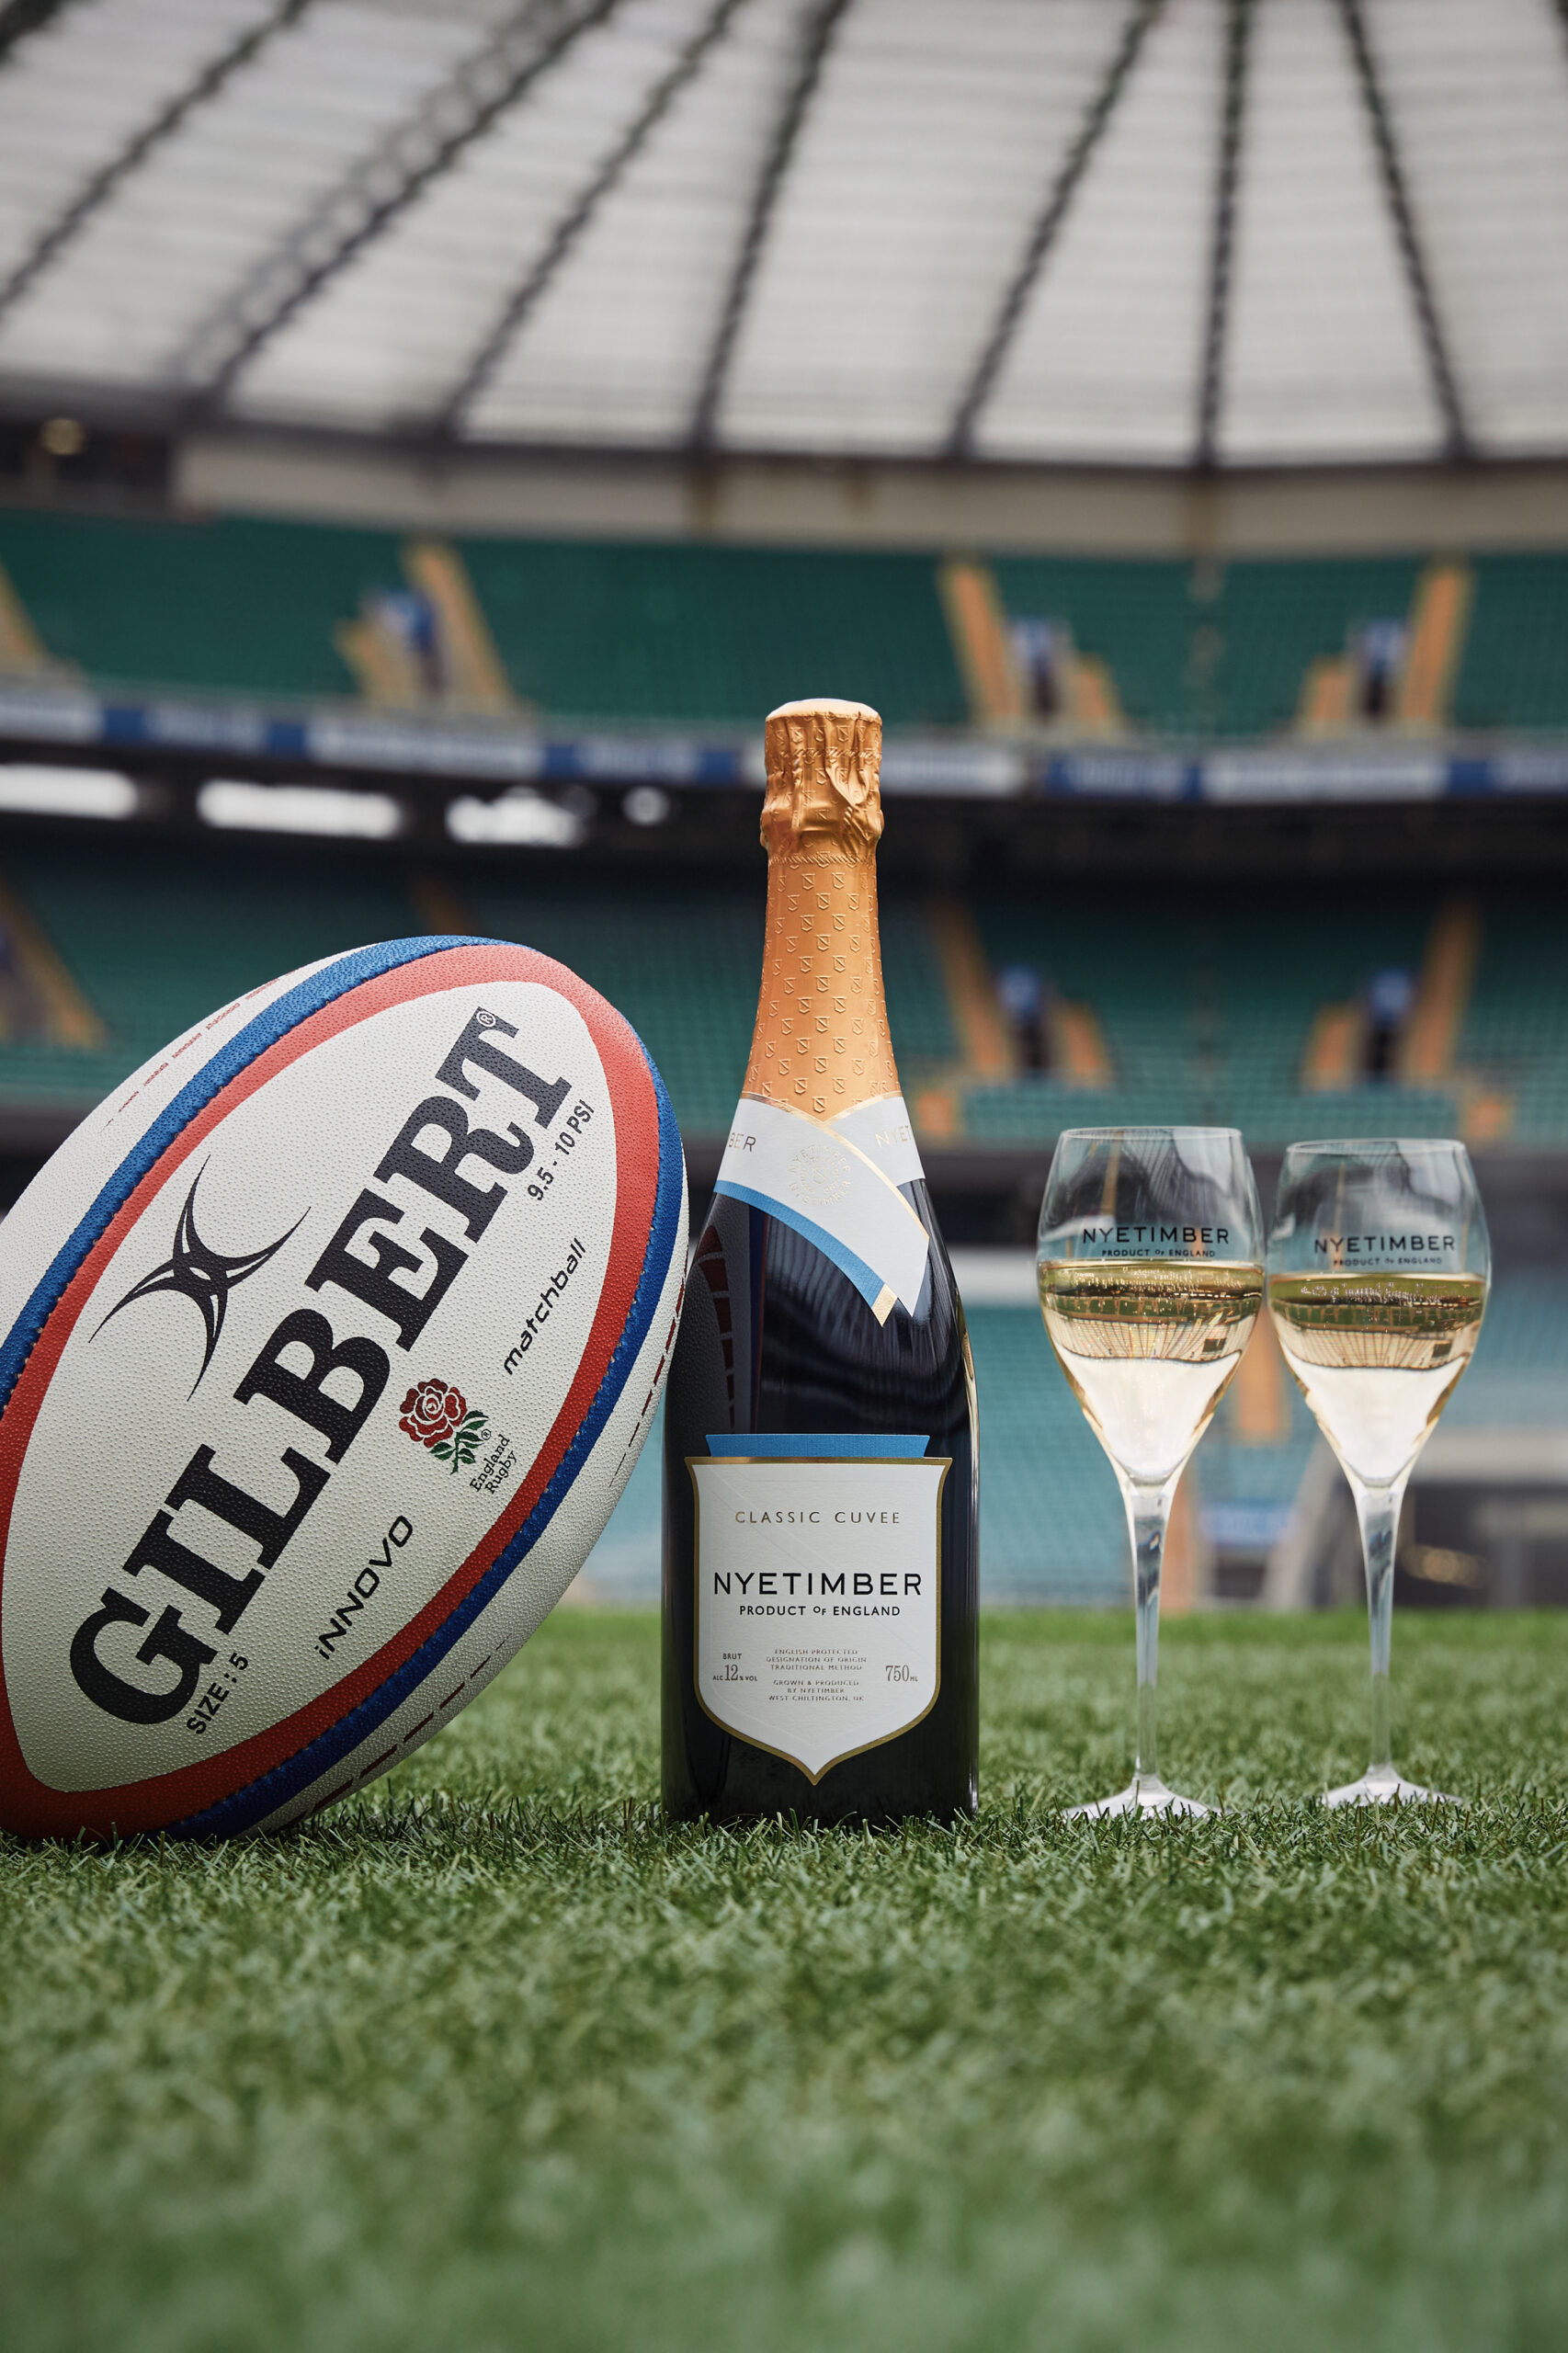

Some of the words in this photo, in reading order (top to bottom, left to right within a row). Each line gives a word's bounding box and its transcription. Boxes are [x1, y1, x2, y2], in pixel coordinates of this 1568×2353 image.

[528, 1166, 554, 1200] 9.5
[555, 1131, 574, 1155] 10
[566, 1099, 595, 1134] PSI
[1083, 1227, 1229, 1244] NYETIMBER
[1314, 1235, 1455, 1254] NYETIMBER
[1169, 1249, 1215, 1257] ENGLAND
[1334, 1257, 1380, 1267] PRODUCT
[504, 1237, 585, 1375] matchball
[70, 1006, 572, 1724] GILBERT
[470, 1434, 510, 1492] England
[484, 1449, 517, 1495] Rugby
[735, 1511, 821, 1523] CLASSIC
[835, 1512, 900, 1523] CUVEE
[714, 1572, 922, 1596] NYETIMBER
[739, 1605, 806, 1616] PRODUCT
[833, 1606, 901, 1616] ENGLAND
[230, 1653, 248, 1670] 5
